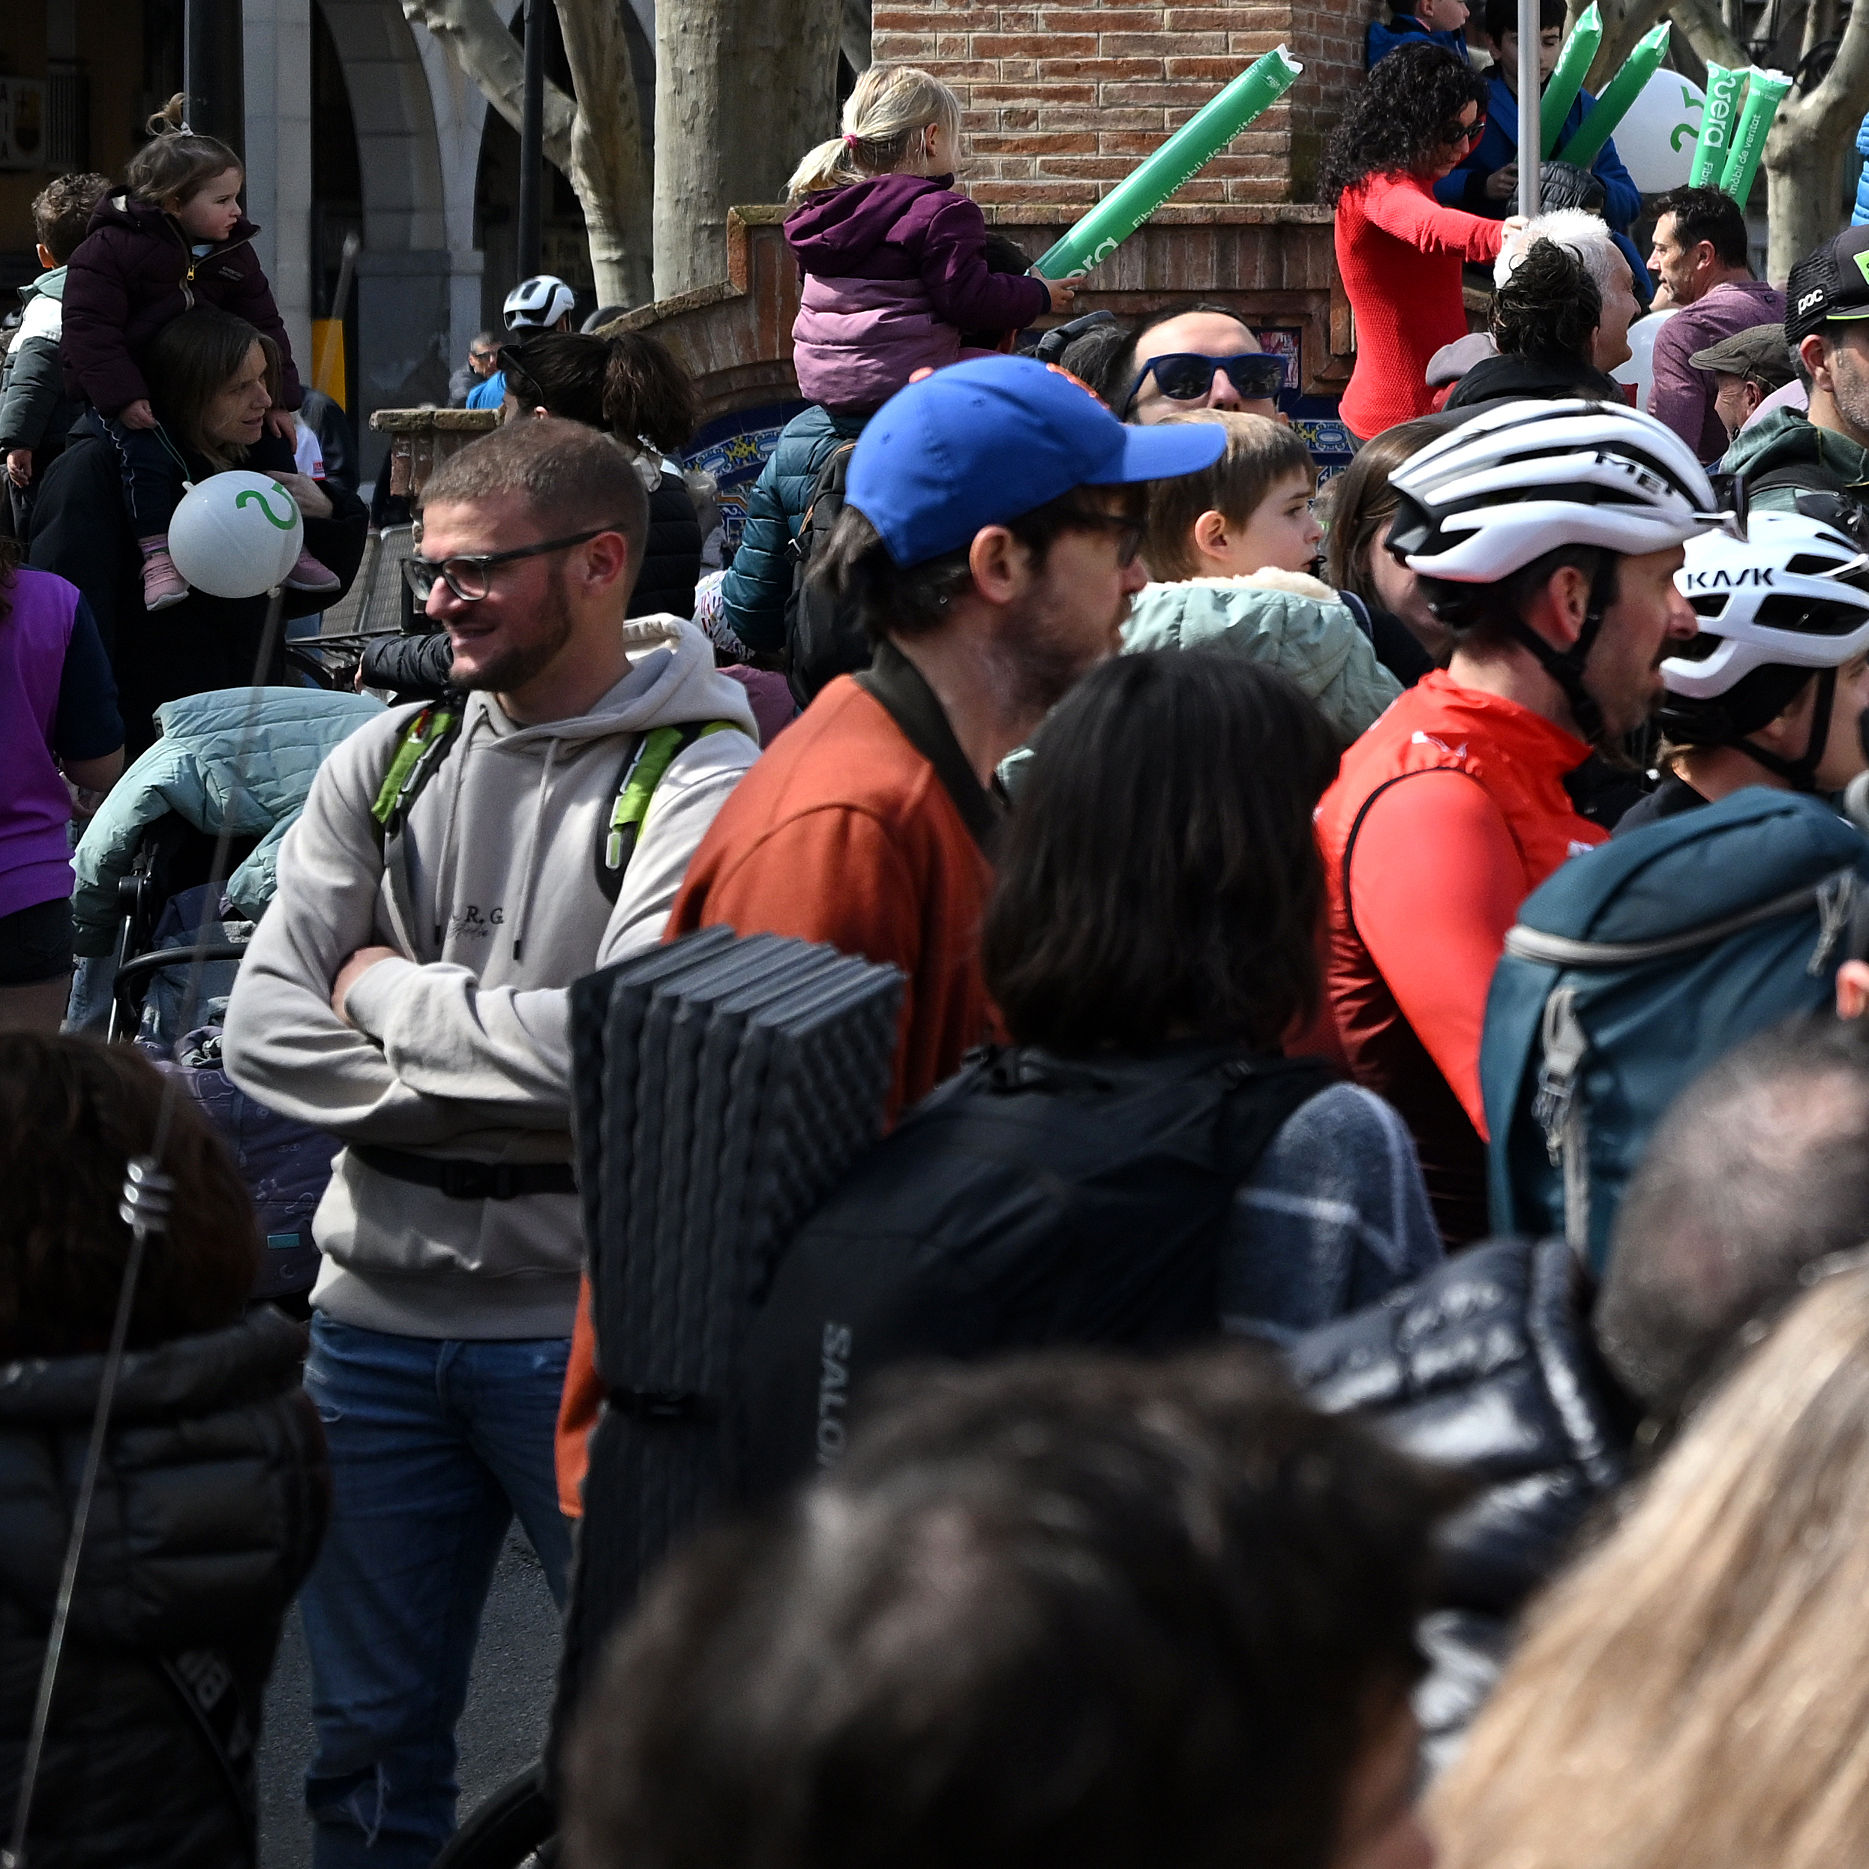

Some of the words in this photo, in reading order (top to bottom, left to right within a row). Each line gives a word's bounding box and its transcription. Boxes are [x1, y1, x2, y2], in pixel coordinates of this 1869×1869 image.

[1131, 200, 1164, 229] Fibra
[1796, 287, 1824, 316] poc
[1686, 566, 1775, 591] KASK
